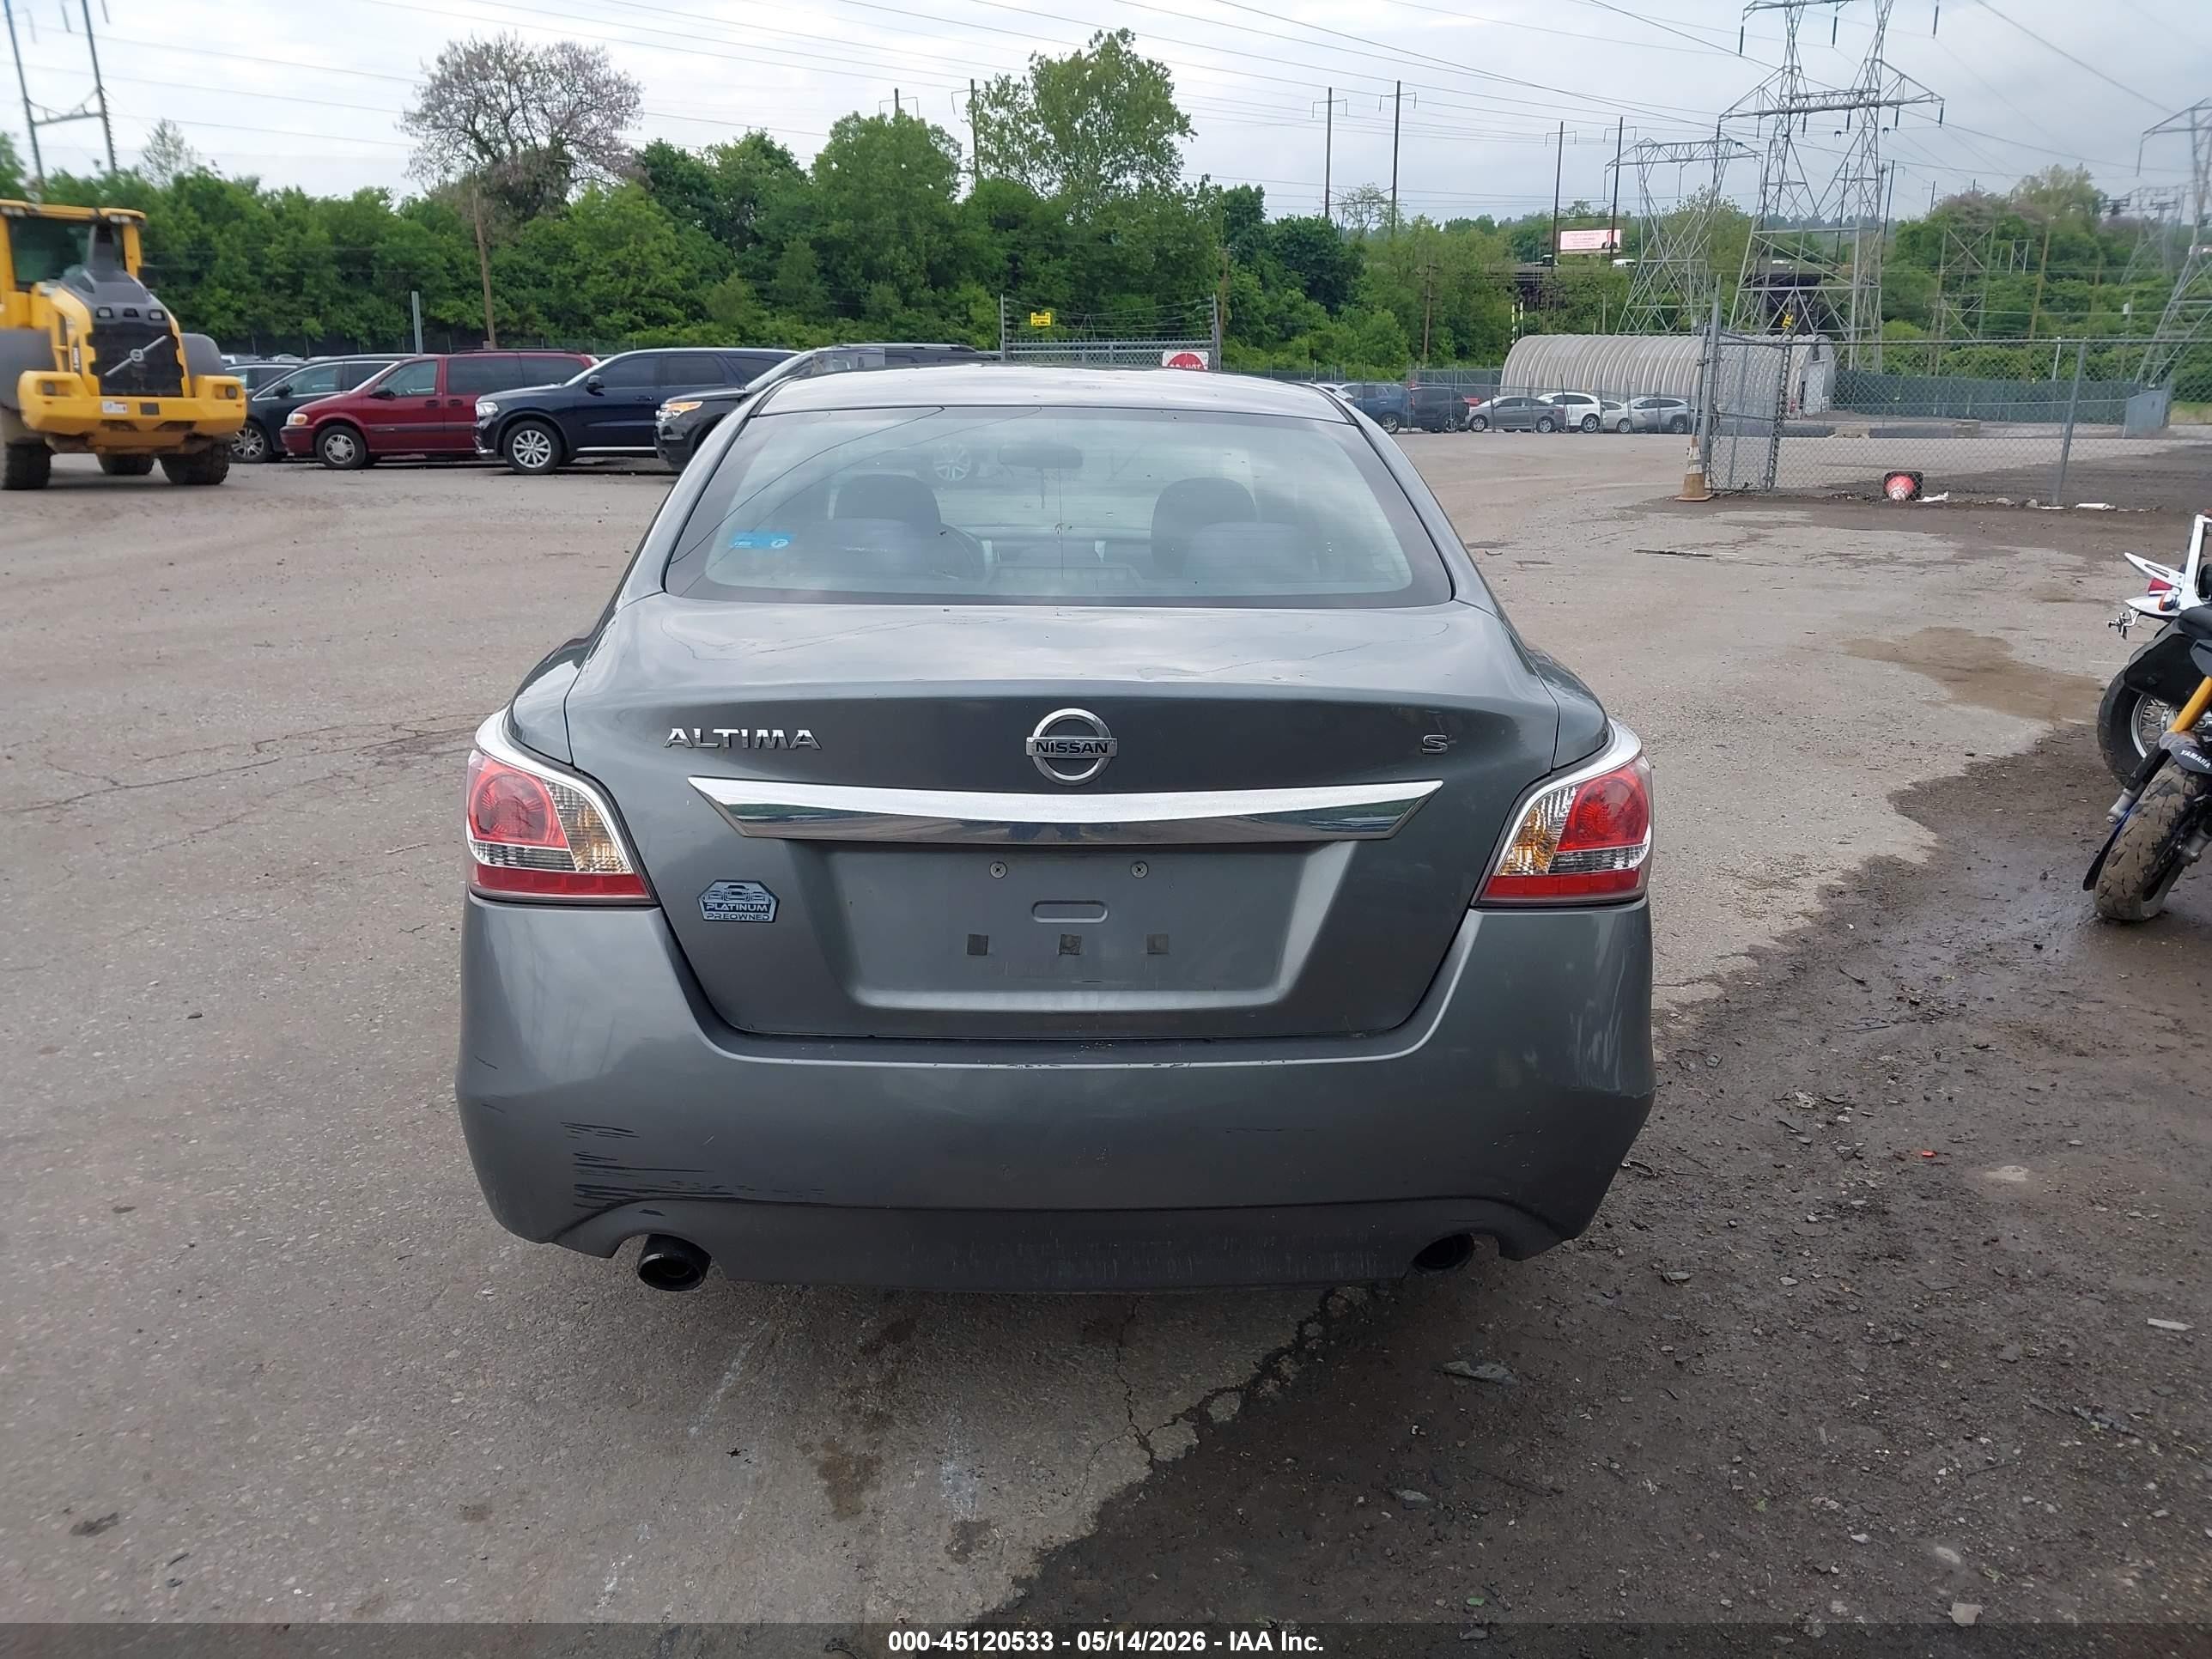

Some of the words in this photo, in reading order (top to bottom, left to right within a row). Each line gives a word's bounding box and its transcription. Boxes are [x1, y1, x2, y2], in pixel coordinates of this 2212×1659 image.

[664, 727, 822, 750] ALTIMA
[1421, 734, 1448, 754] S
[1036, 741, 1108, 754] NISSAN
[2180, 749, 2211, 769] YAMAHA
[706, 902, 769, 912] PLATINUM
[706, 912, 770, 921] PREOWNED
